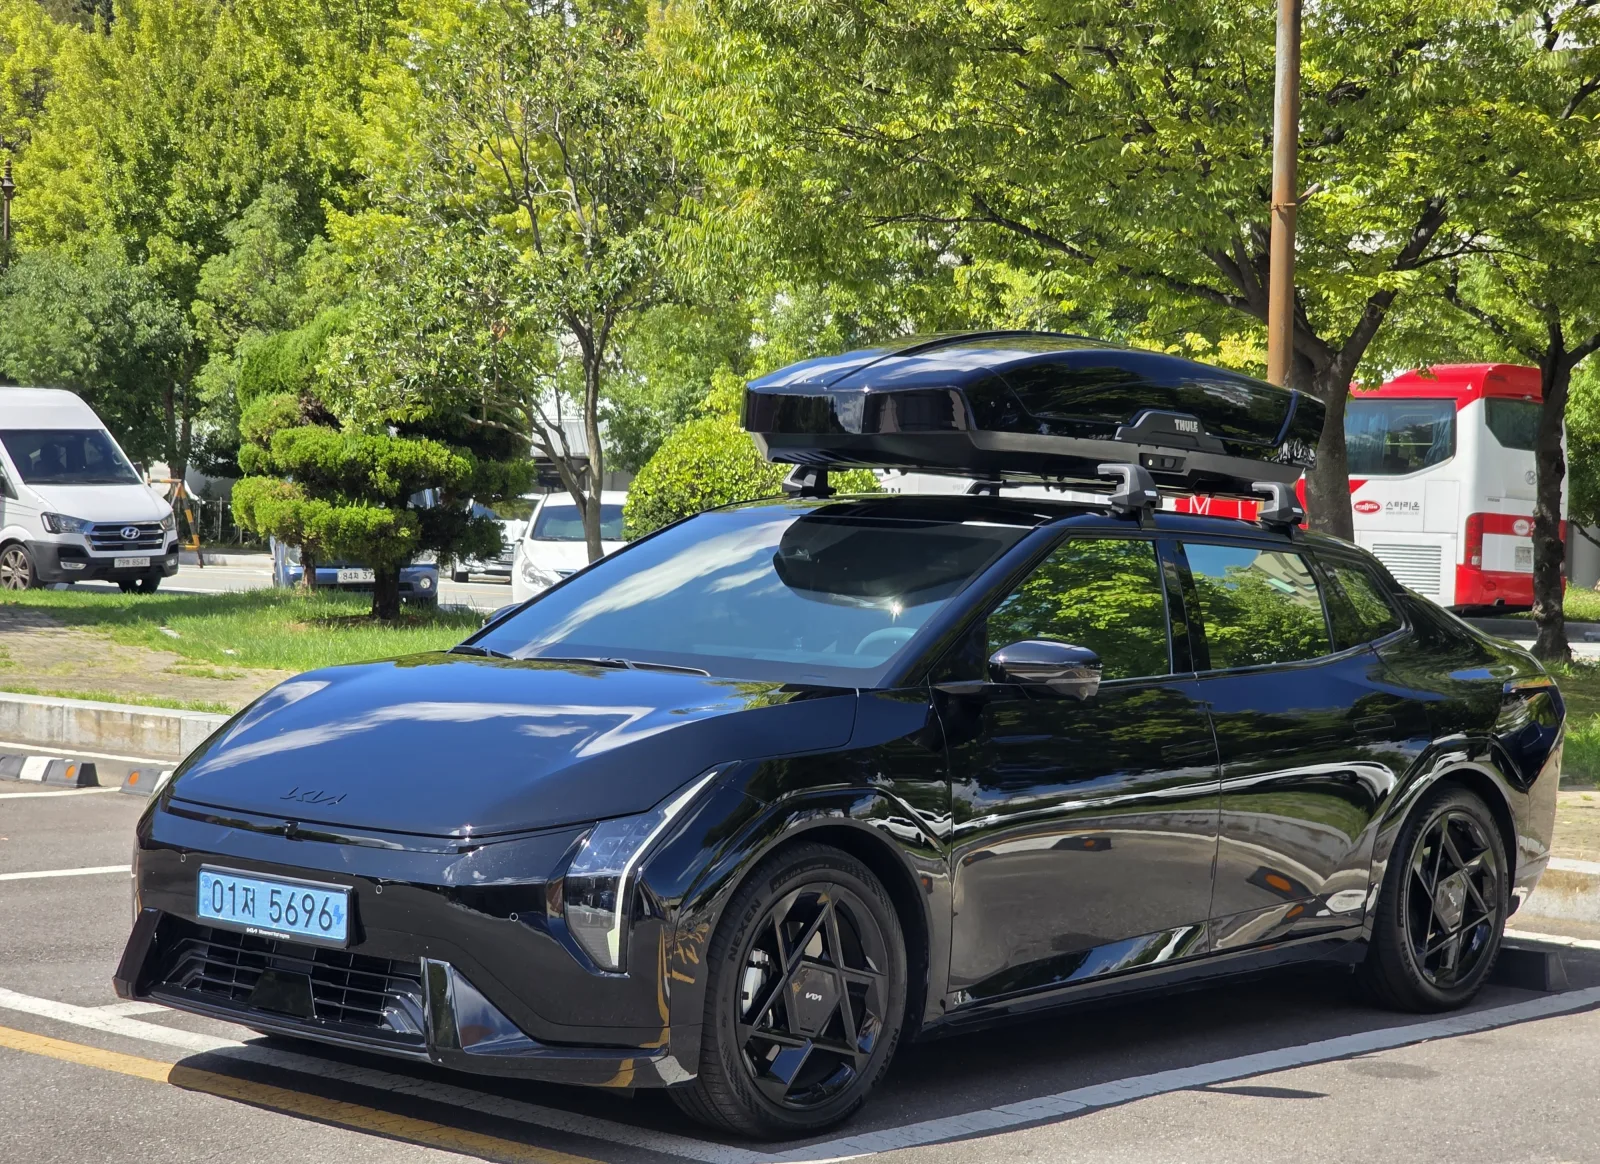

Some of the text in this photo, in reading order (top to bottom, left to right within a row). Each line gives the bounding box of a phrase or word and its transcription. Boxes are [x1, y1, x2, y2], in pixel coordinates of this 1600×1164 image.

[1174, 419, 1198, 433] THULE
[1385, 501, 1420, 511] 스타리온
[279, 786, 348, 806] KIA
[211, 879, 334, 932] 01저 5696
[727, 898, 762, 962] NEXEN
[805, 991, 823, 1002] KIA
